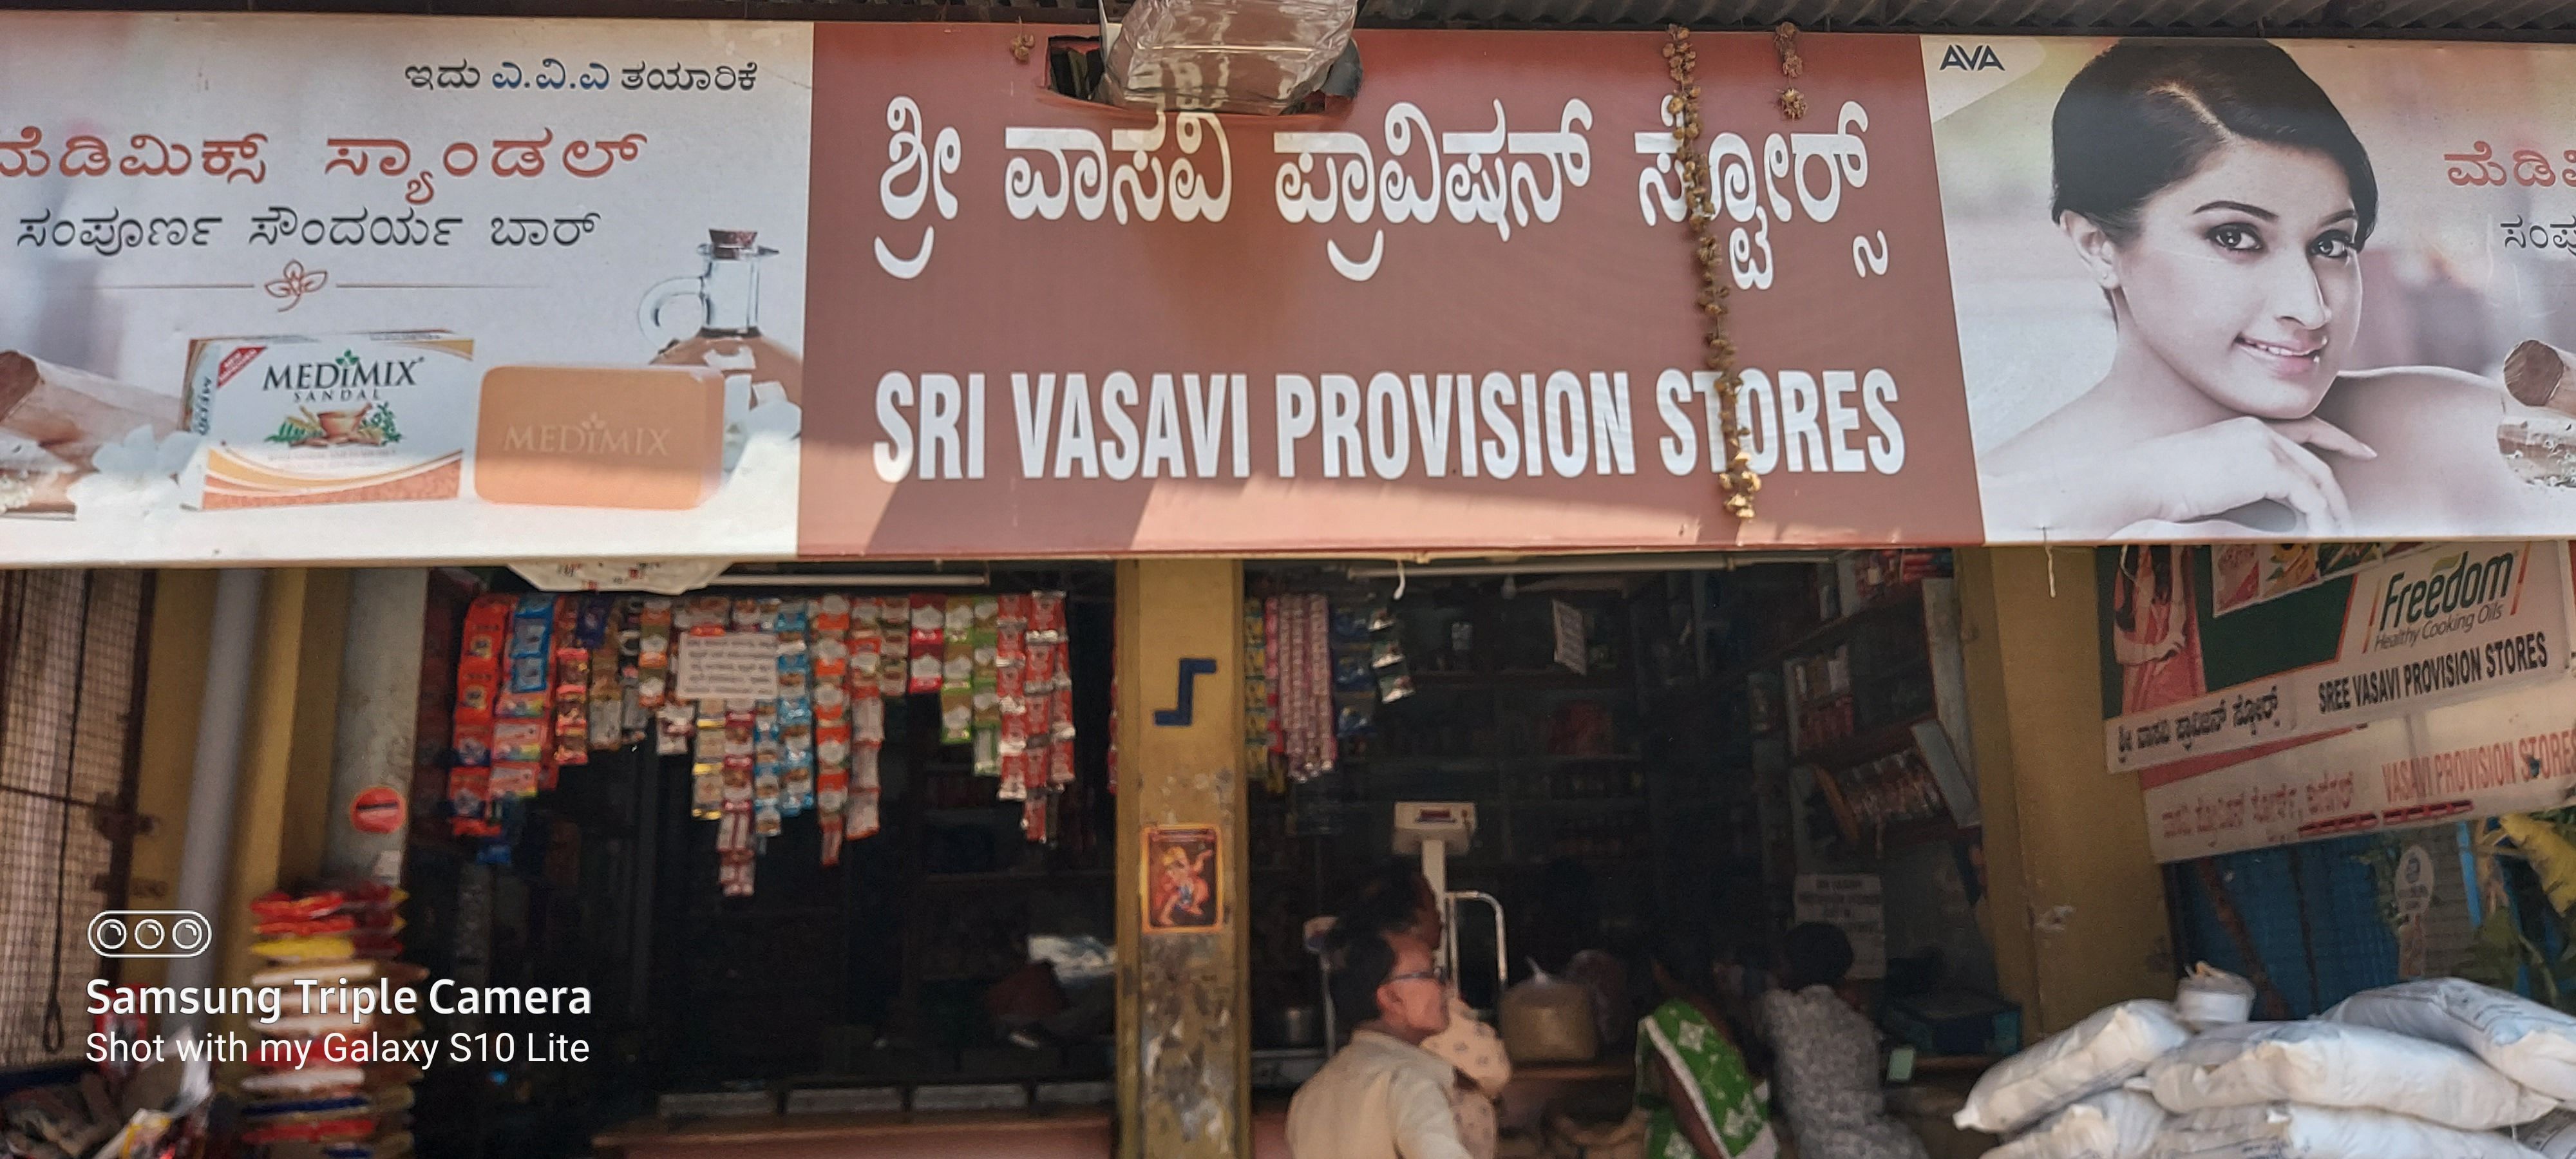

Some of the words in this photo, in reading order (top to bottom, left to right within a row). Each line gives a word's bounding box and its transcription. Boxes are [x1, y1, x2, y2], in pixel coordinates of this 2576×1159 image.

[404, 58, 481, 91] ಇದು
[492, 59, 611, 91] ಎ.ವಿ.ಎ
[621, 61, 758, 91] ತಯಾರಿಕೆ
[1940, 44, 2005, 71] AVA
[0, 126, 268, 184] ಮೆಡಿಮಿಕ್ಸ್
[325, 127, 648, 205] ಸ್ಯಾಂಡಲ್
[874, 95, 961, 279] ಶ್ರೀ
[1005, 110, 1233, 225] ವಾಸವಿ
[1274, 97, 1593, 281] ಪ್ರಾವಿಷನ್
[1634, 94, 1889, 290] ಸ್ಟೋರ್ಸ್
[17, 207, 223, 256] ಸಂಪೂರ್ಣ
[249, 205, 464, 247] ಸೌಂದರ್ಯ
[491, 212, 601, 247] ಬಾರ್
[293, 388, 382, 403] SANDAL
[873, 371, 985, 484] SRI
[1011, 370, 1251, 482] VASAVI
[1275, 369, 1637, 480] PROVISION
[1655, 368, 1906, 477] STORES
[2380, 551, 2514, 632] Freedom
[2374, 627, 2421, 652] Healthy
[2421, 611, 2476, 641] Cooking
[2477, 601, 2505, 625] Oils
[2318, 676, 2351, 715] SREE
[2351, 665, 2401, 707] VASAVI
[2402, 645, 2482, 697] PROVISION
[2485, 631, 2549, 679] STORES
[2381, 756, 2433, 804] VASAVI
[2434, 741, 2517, 795] PROVISION
